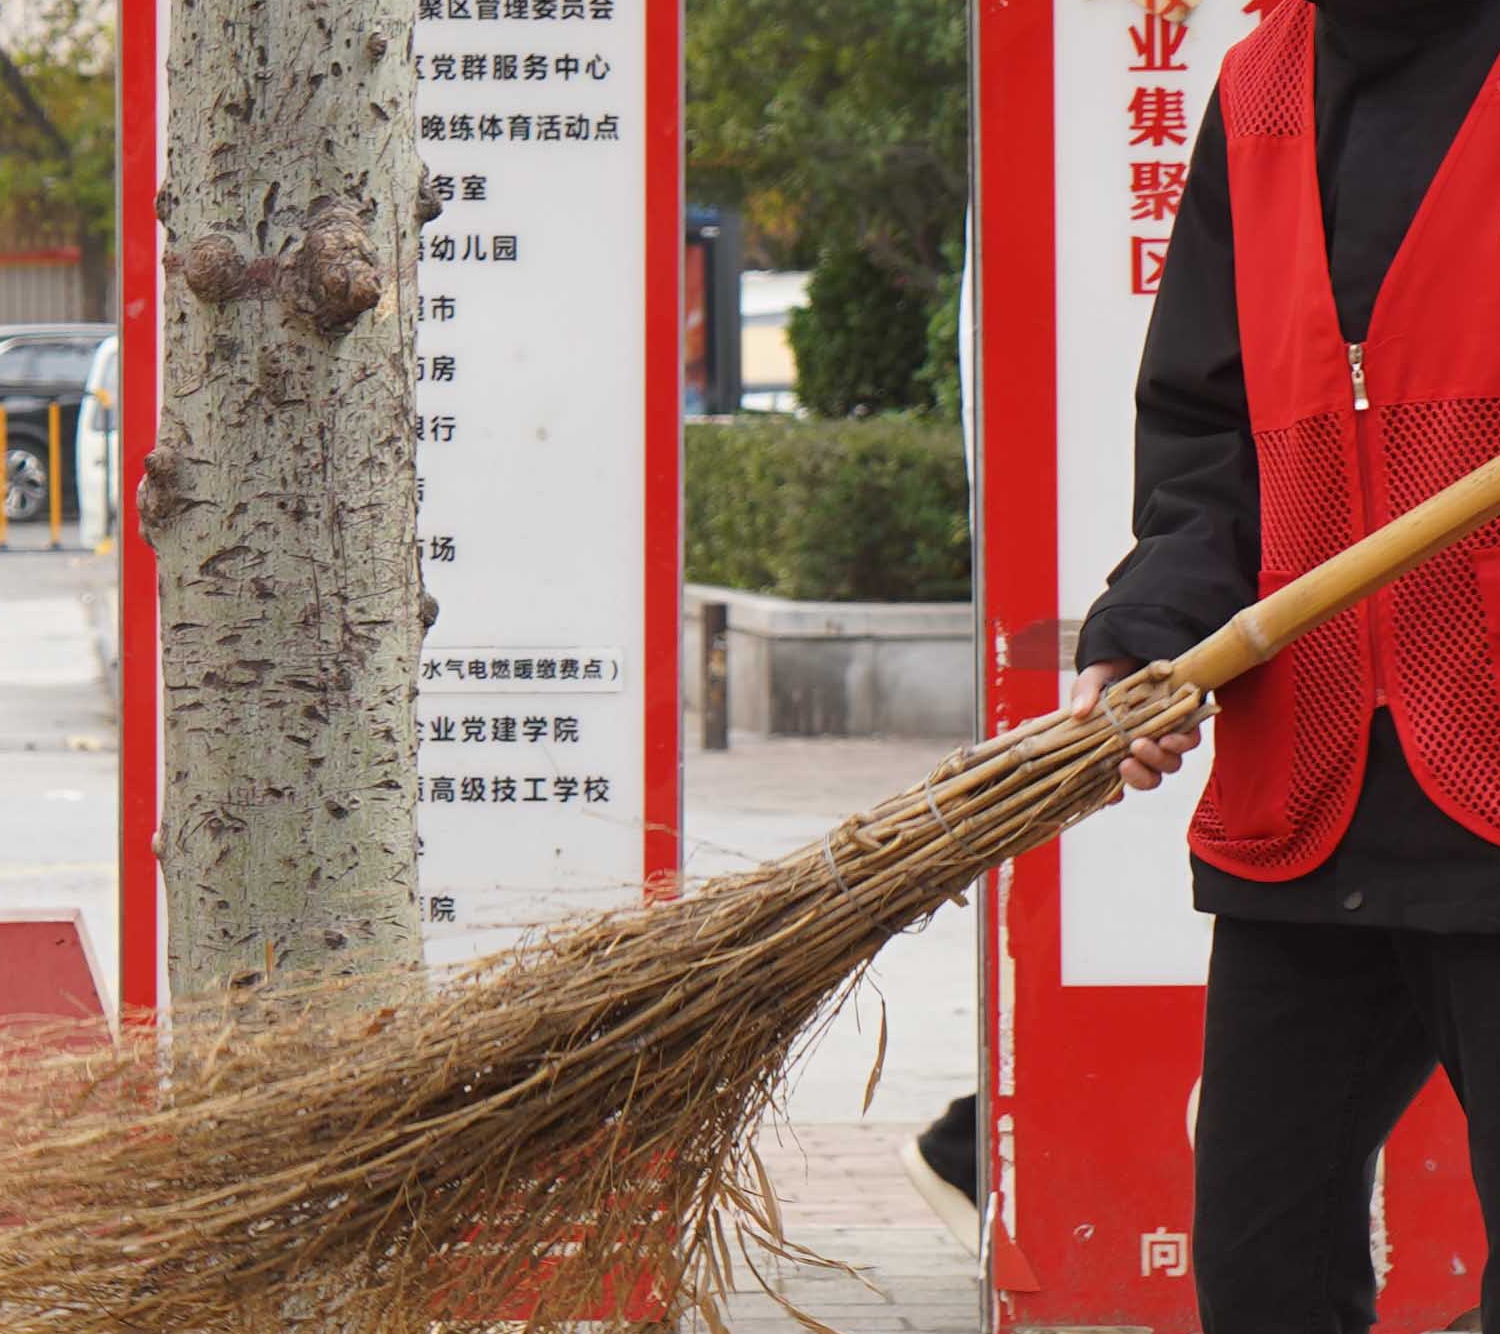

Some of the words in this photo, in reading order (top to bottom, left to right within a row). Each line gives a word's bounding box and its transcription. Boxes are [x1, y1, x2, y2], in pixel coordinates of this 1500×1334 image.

[421, 115, 620, 141] 晚练体育活动点
[1127, 12, 1189, 295] 业集聚区
[432, 174, 487, 201] 务室
[418, 896, 455, 923] 院
[1141, 1228, 1188, 1278] 向
